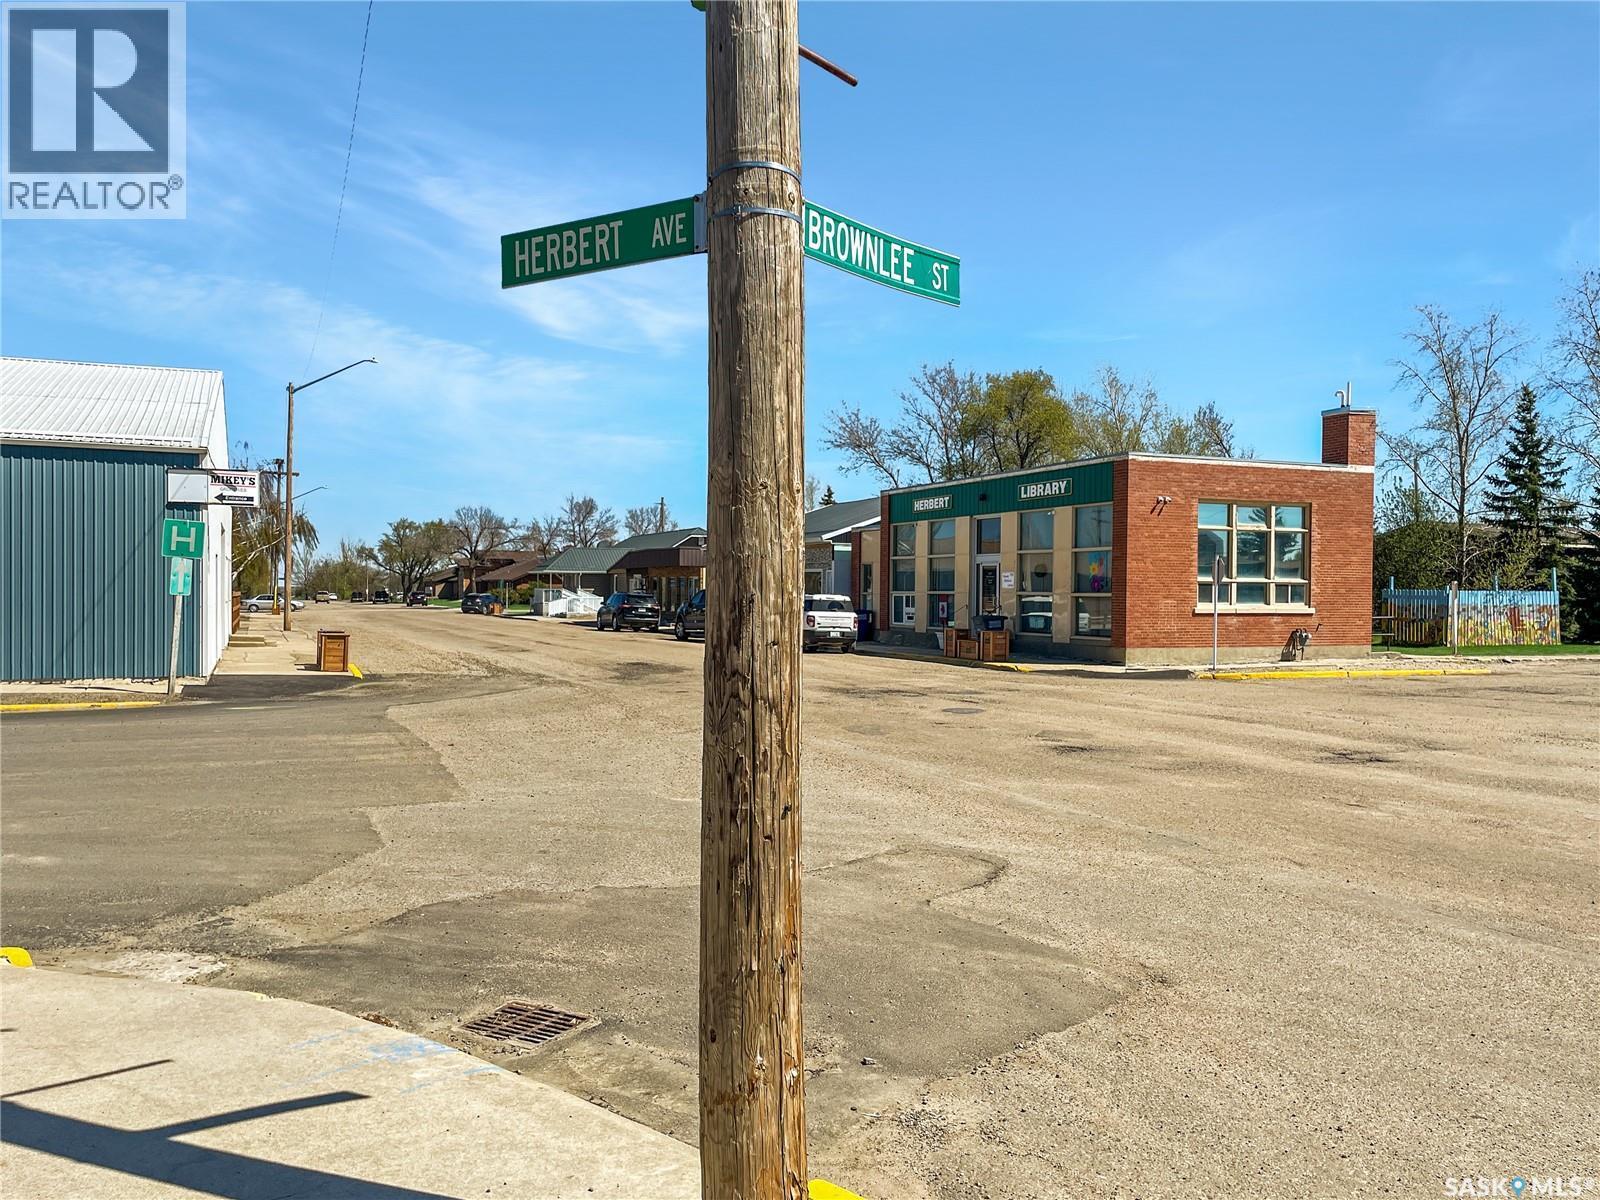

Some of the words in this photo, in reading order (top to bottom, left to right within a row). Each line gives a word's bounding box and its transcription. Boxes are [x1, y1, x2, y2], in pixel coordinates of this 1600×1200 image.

[515, 220, 623, 278] HERBERT
[652, 212, 687, 248] AVE
[808, 208, 915, 285] BROWNLEE
[932, 262, 950, 293] ST
[211, 475, 256, 486] MIKEY'S
[914, 497, 950, 512] HERBERT
[1020, 481, 1068, 499] LIBRARY
[171, 526, 196, 552] H
